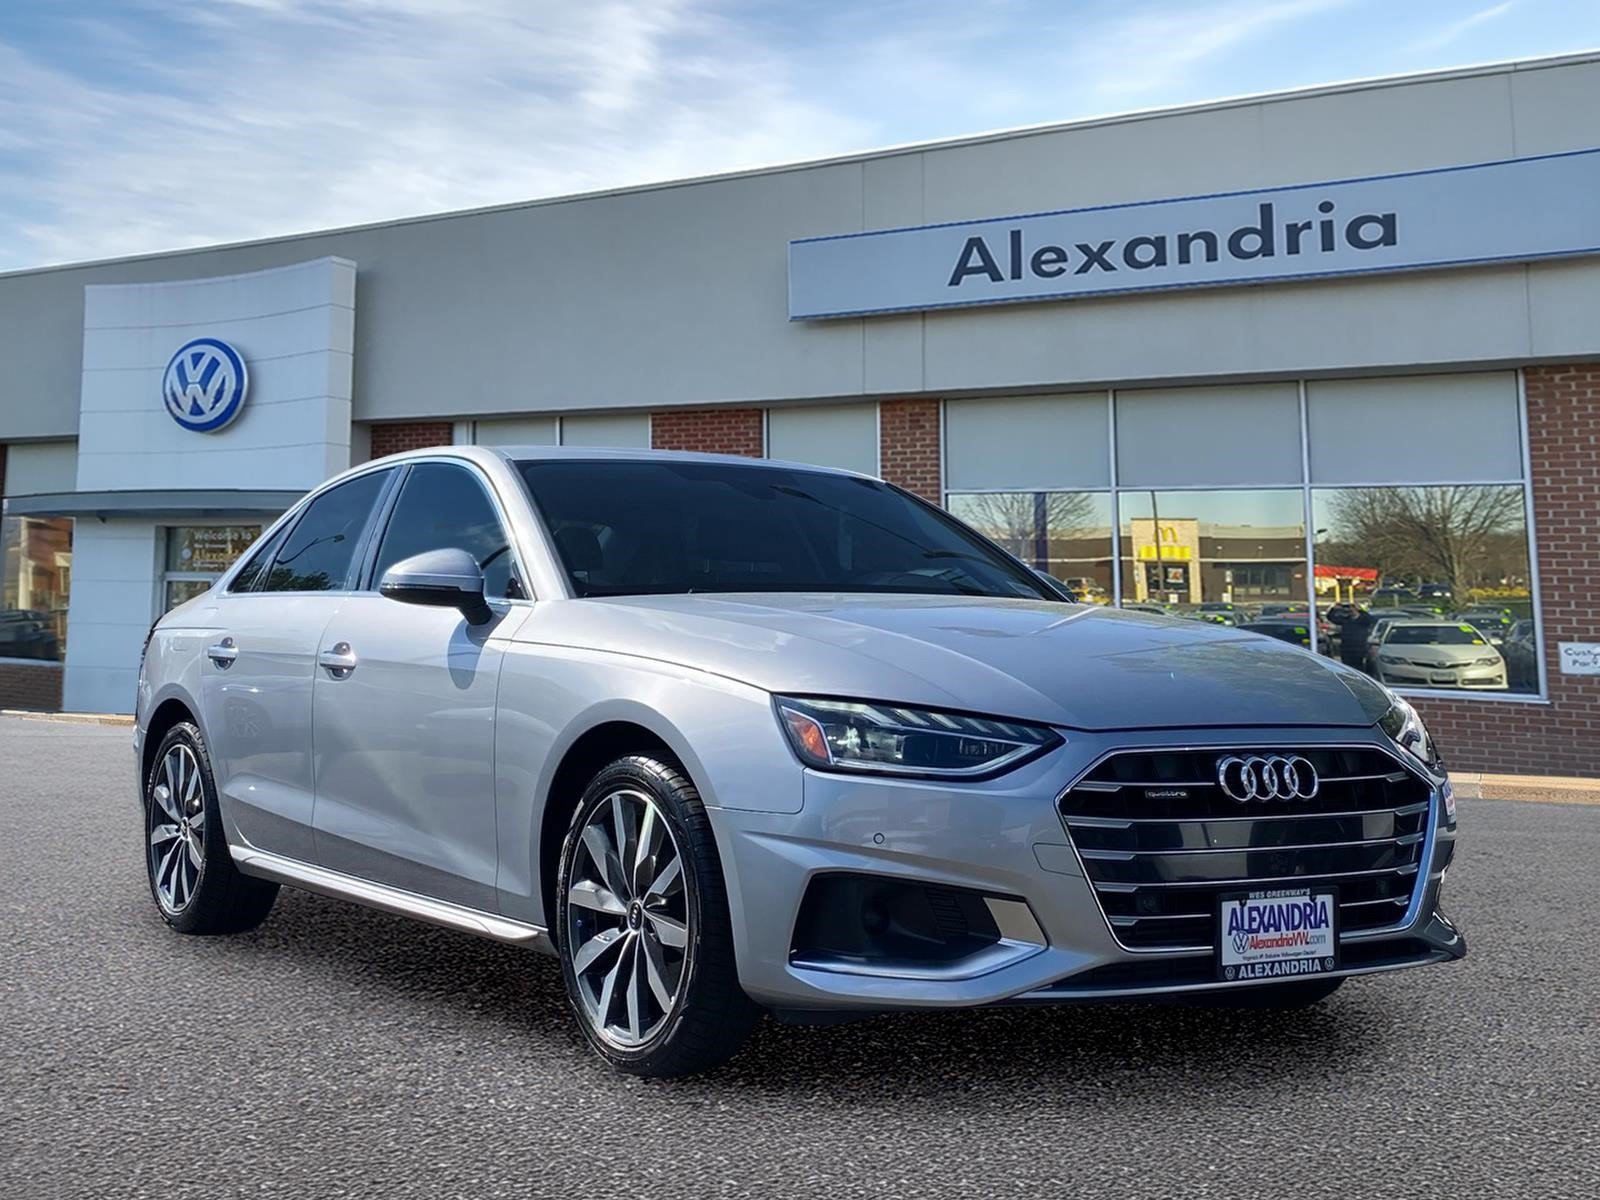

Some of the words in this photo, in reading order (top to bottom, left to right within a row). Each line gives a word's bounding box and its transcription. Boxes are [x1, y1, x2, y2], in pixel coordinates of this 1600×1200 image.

[948, 200, 1398, 287] Alexandria
[1147, 790, 1187, 798] quattro
[1249, 891, 1265, 899] WES
[1228, 901, 1330, 936] ALEXANDRIA
[1238, 958, 1322, 979] ALEXANDRIA
